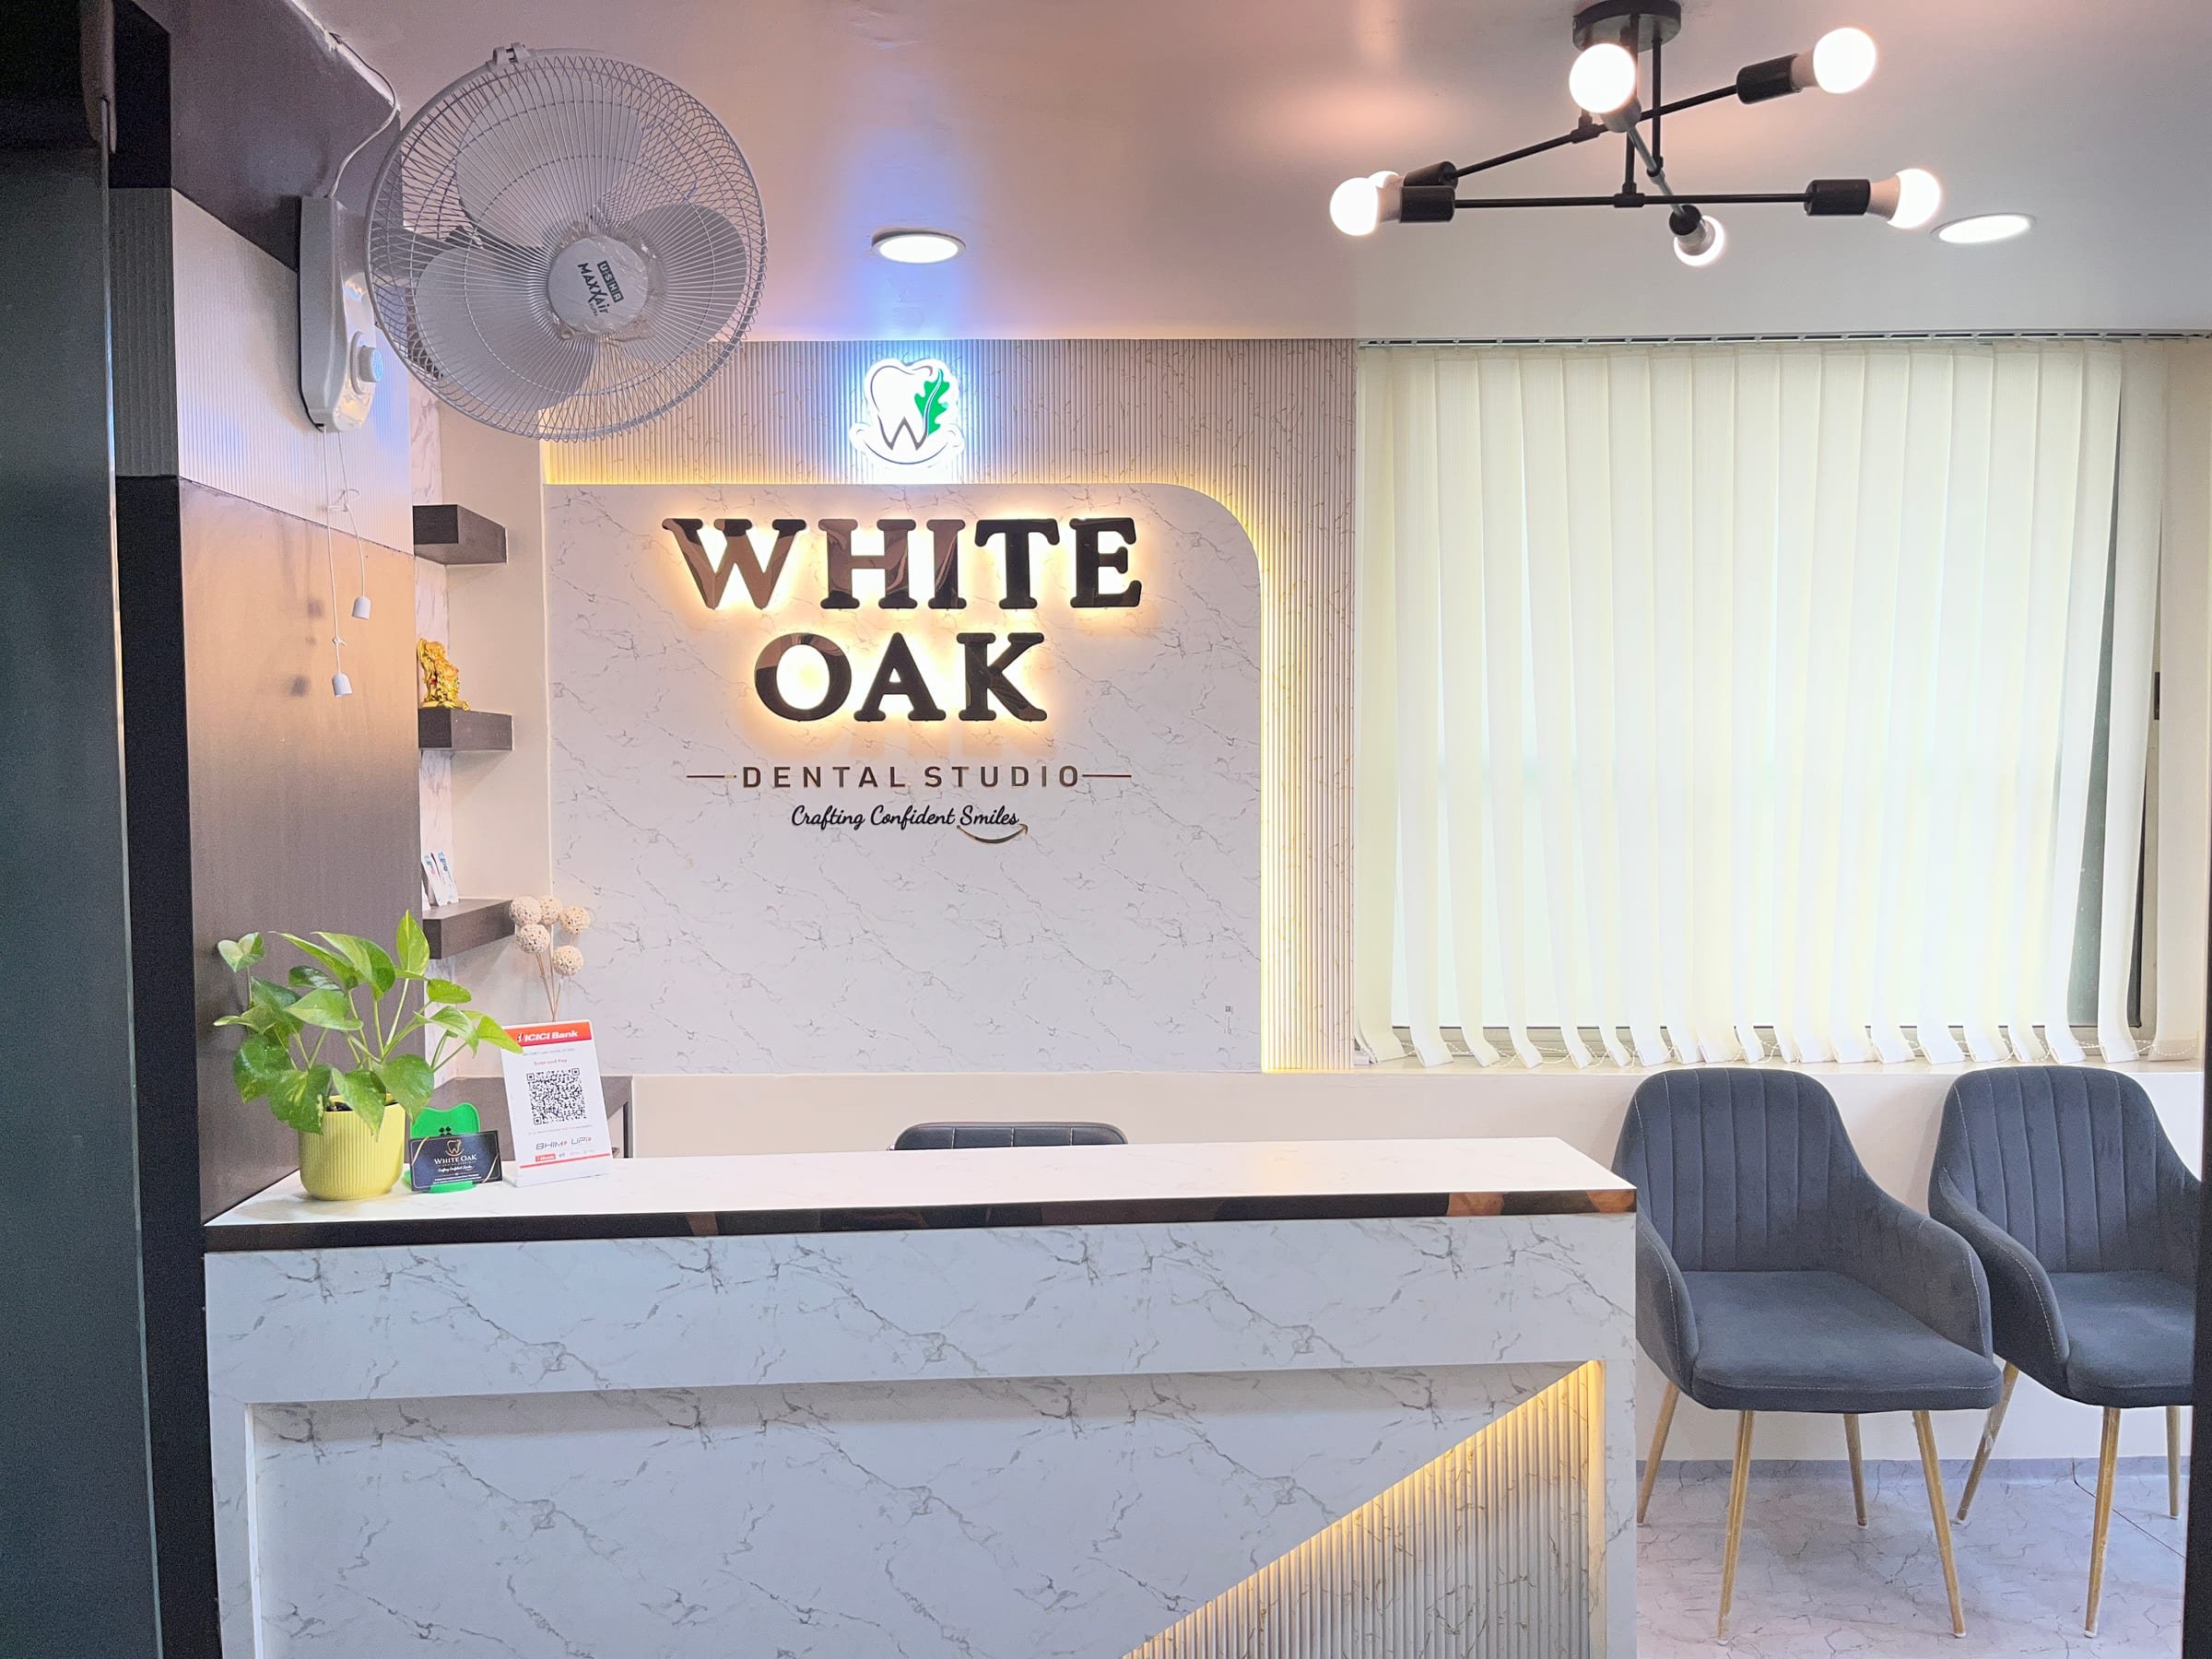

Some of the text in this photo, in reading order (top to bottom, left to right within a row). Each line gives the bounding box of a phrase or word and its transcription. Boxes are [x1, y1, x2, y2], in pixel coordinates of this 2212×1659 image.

[598, 262, 623, 301] USHA
[661, 518, 1142, 609] WHITE
[754, 632, 1048, 722] OAK
[742, 765, 1079, 788] DENTAL STUDIO
[791, 805, 1019, 830] Crafting Confident Smiles
[524, 1030, 578, 1041] ICICI Bank
